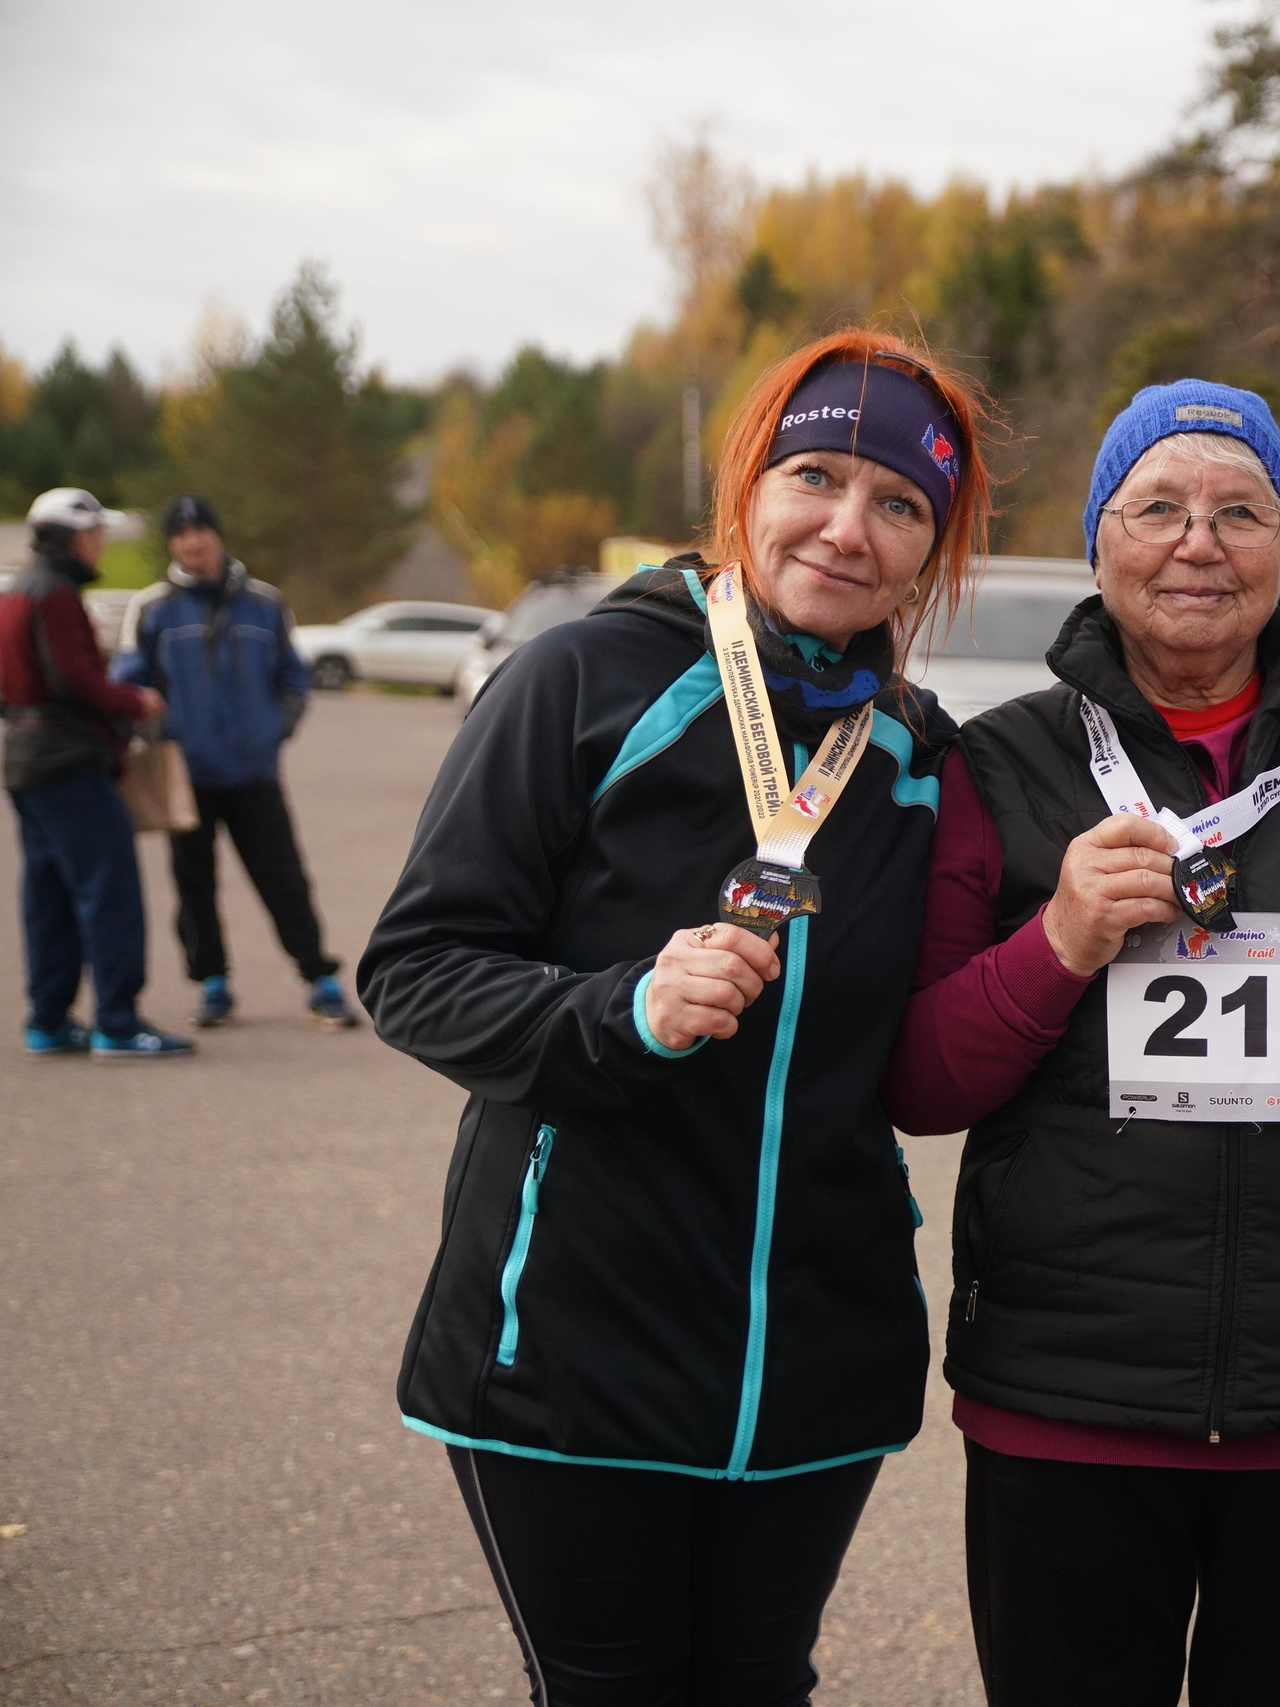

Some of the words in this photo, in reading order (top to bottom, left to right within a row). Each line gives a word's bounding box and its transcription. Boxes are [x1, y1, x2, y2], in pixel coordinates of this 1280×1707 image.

[781, 405, 861, 431] Rostec
[730, 648, 765, 722] ДЕМИНСКИЙ
[749, 721, 778, 777] БЕГОВОЙ
[725, 664, 739, 699] СУПЕРКУБКА
[733, 698, 746, 731] ДЕМИНСКИХ
[740, 729, 753, 765] МАРАФОНОВ
[748, 764, 758, 791] POWERUP
[753, 789, 766, 820] 2021/2022
[1191, 816, 1220, 835] mino
[1220, 929, 1266, 941] Demino
[1247, 947, 1275, 958] trail
[1209, 1097, 1253, 1106] SUUNTO
